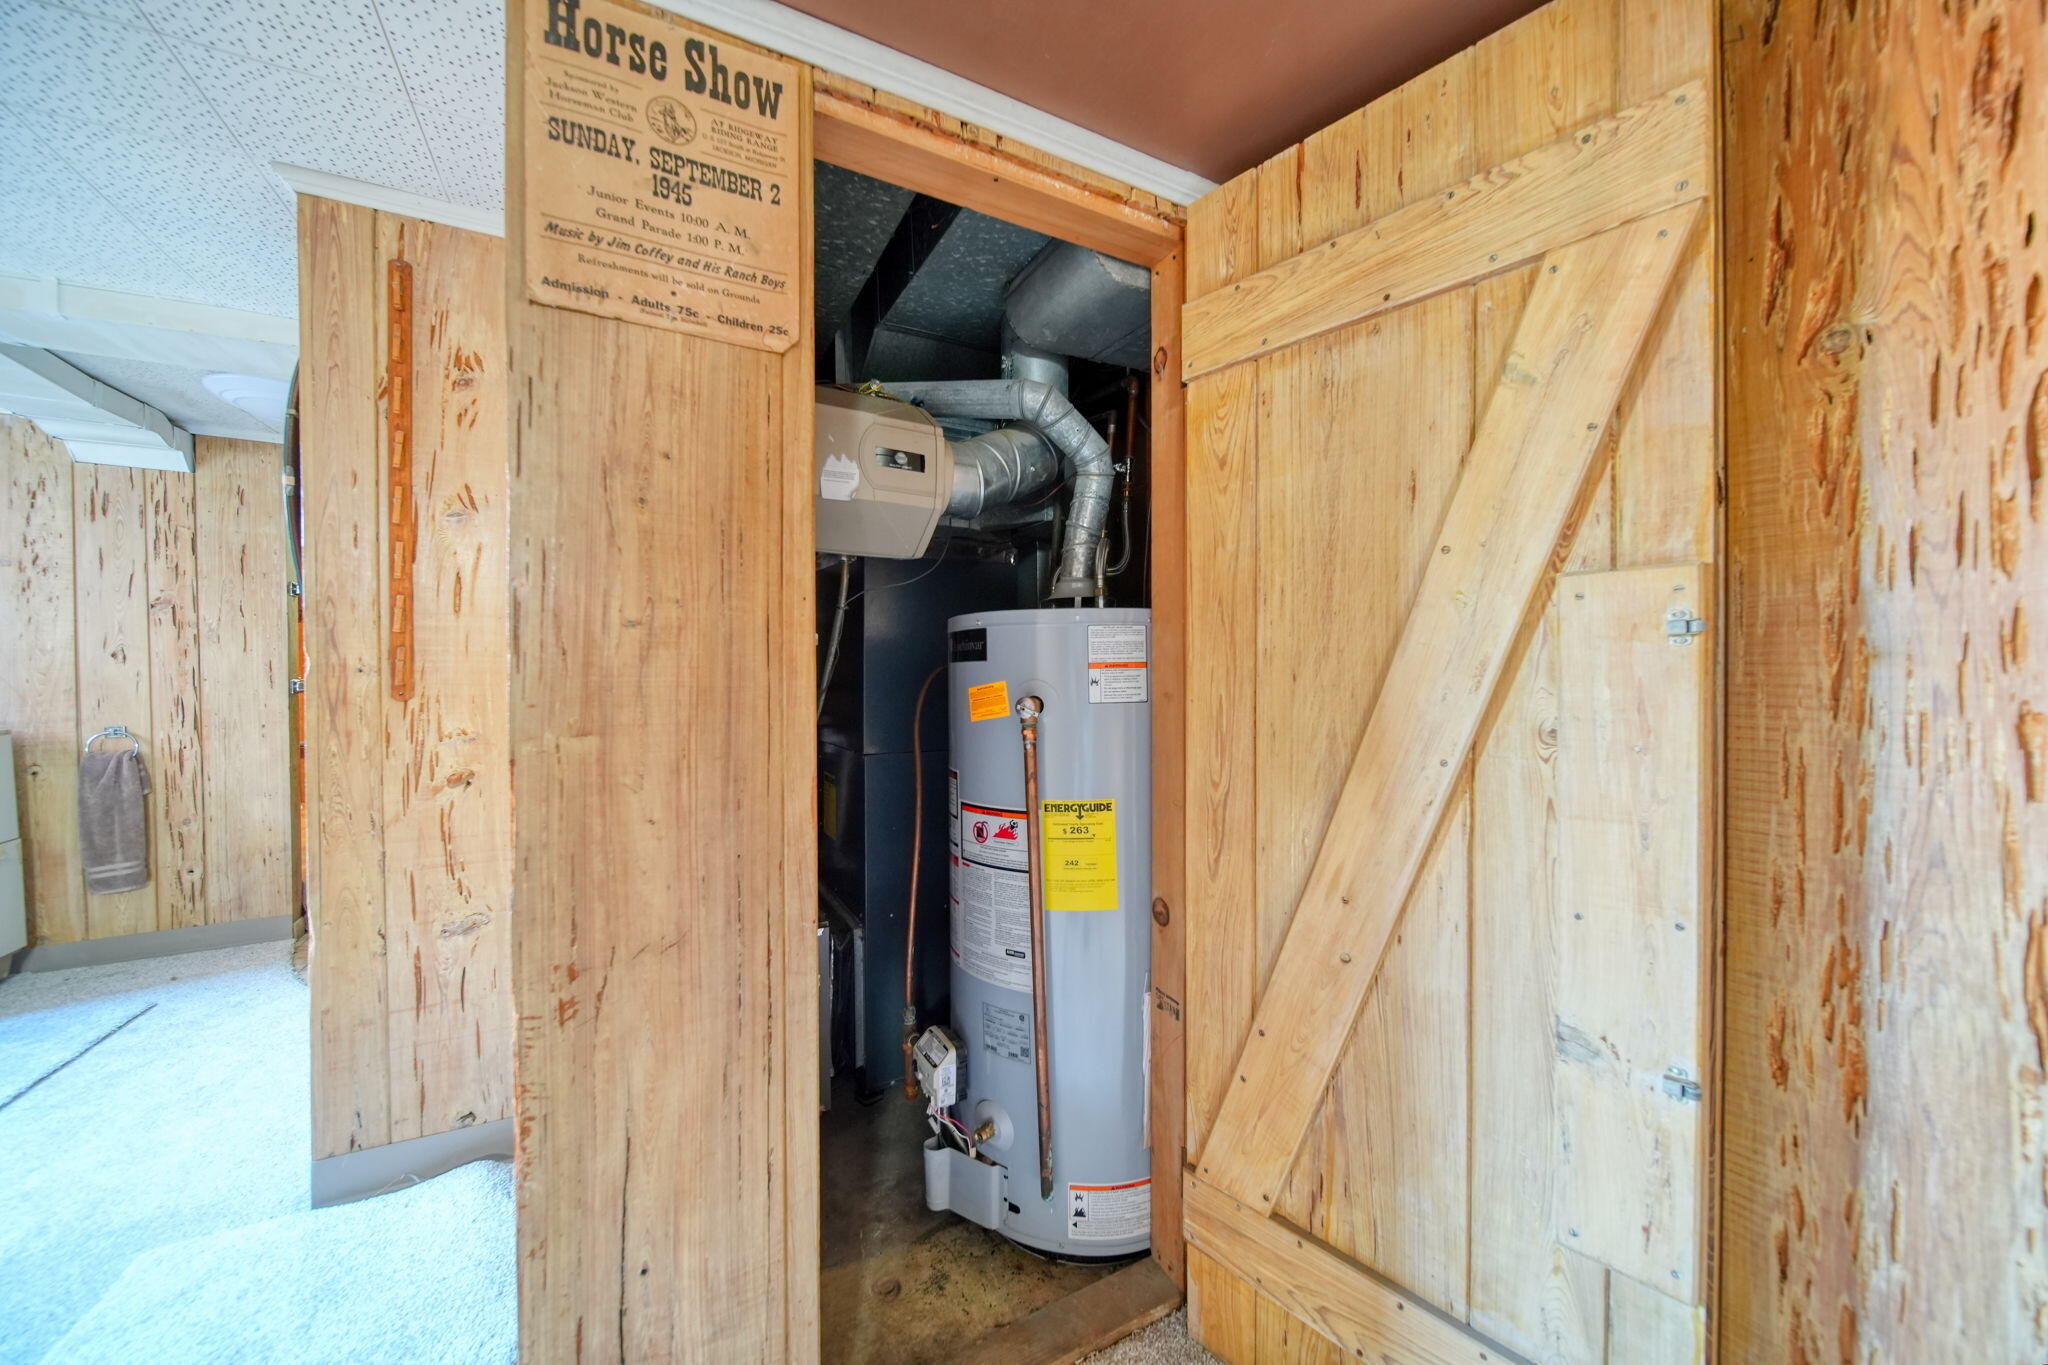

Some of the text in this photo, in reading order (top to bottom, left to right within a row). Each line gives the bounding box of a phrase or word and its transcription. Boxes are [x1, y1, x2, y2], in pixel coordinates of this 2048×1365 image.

[543, 0, 783, 120] Horse Show
[609, 108, 633, 122] Club
[649, 146, 762, 202] SEPTEMBER
[770, 184, 781, 205] 2
[652, 173, 692, 206] 1945
[587, 185, 629, 204] Junior
[635, 198, 675, 220] Events
[681, 213, 709, 229] 10:00
[595, 207, 635, 226] Grand
[642, 219, 682, 240] Parade
[687, 233, 709, 246] 1:00
[544, 221, 786, 290] Music by Jim Coffey and His Ranch Boys
[577, 252, 649, 278] Refreshments
[651, 272, 669, 284] will
[686, 280, 705, 292] sold
[722, 288, 761, 305] Grounds
[541, 275, 609, 299] Admission
[631, 294, 671, 312] Adults
[677, 305, 700, 319] 75c
[717, 313, 764, 333] Children
[769, 324, 790, 337] 25c
[1044, 802, 1113, 814] ENERGYGUIDE
[1069, 826, 1089, 834] 263
